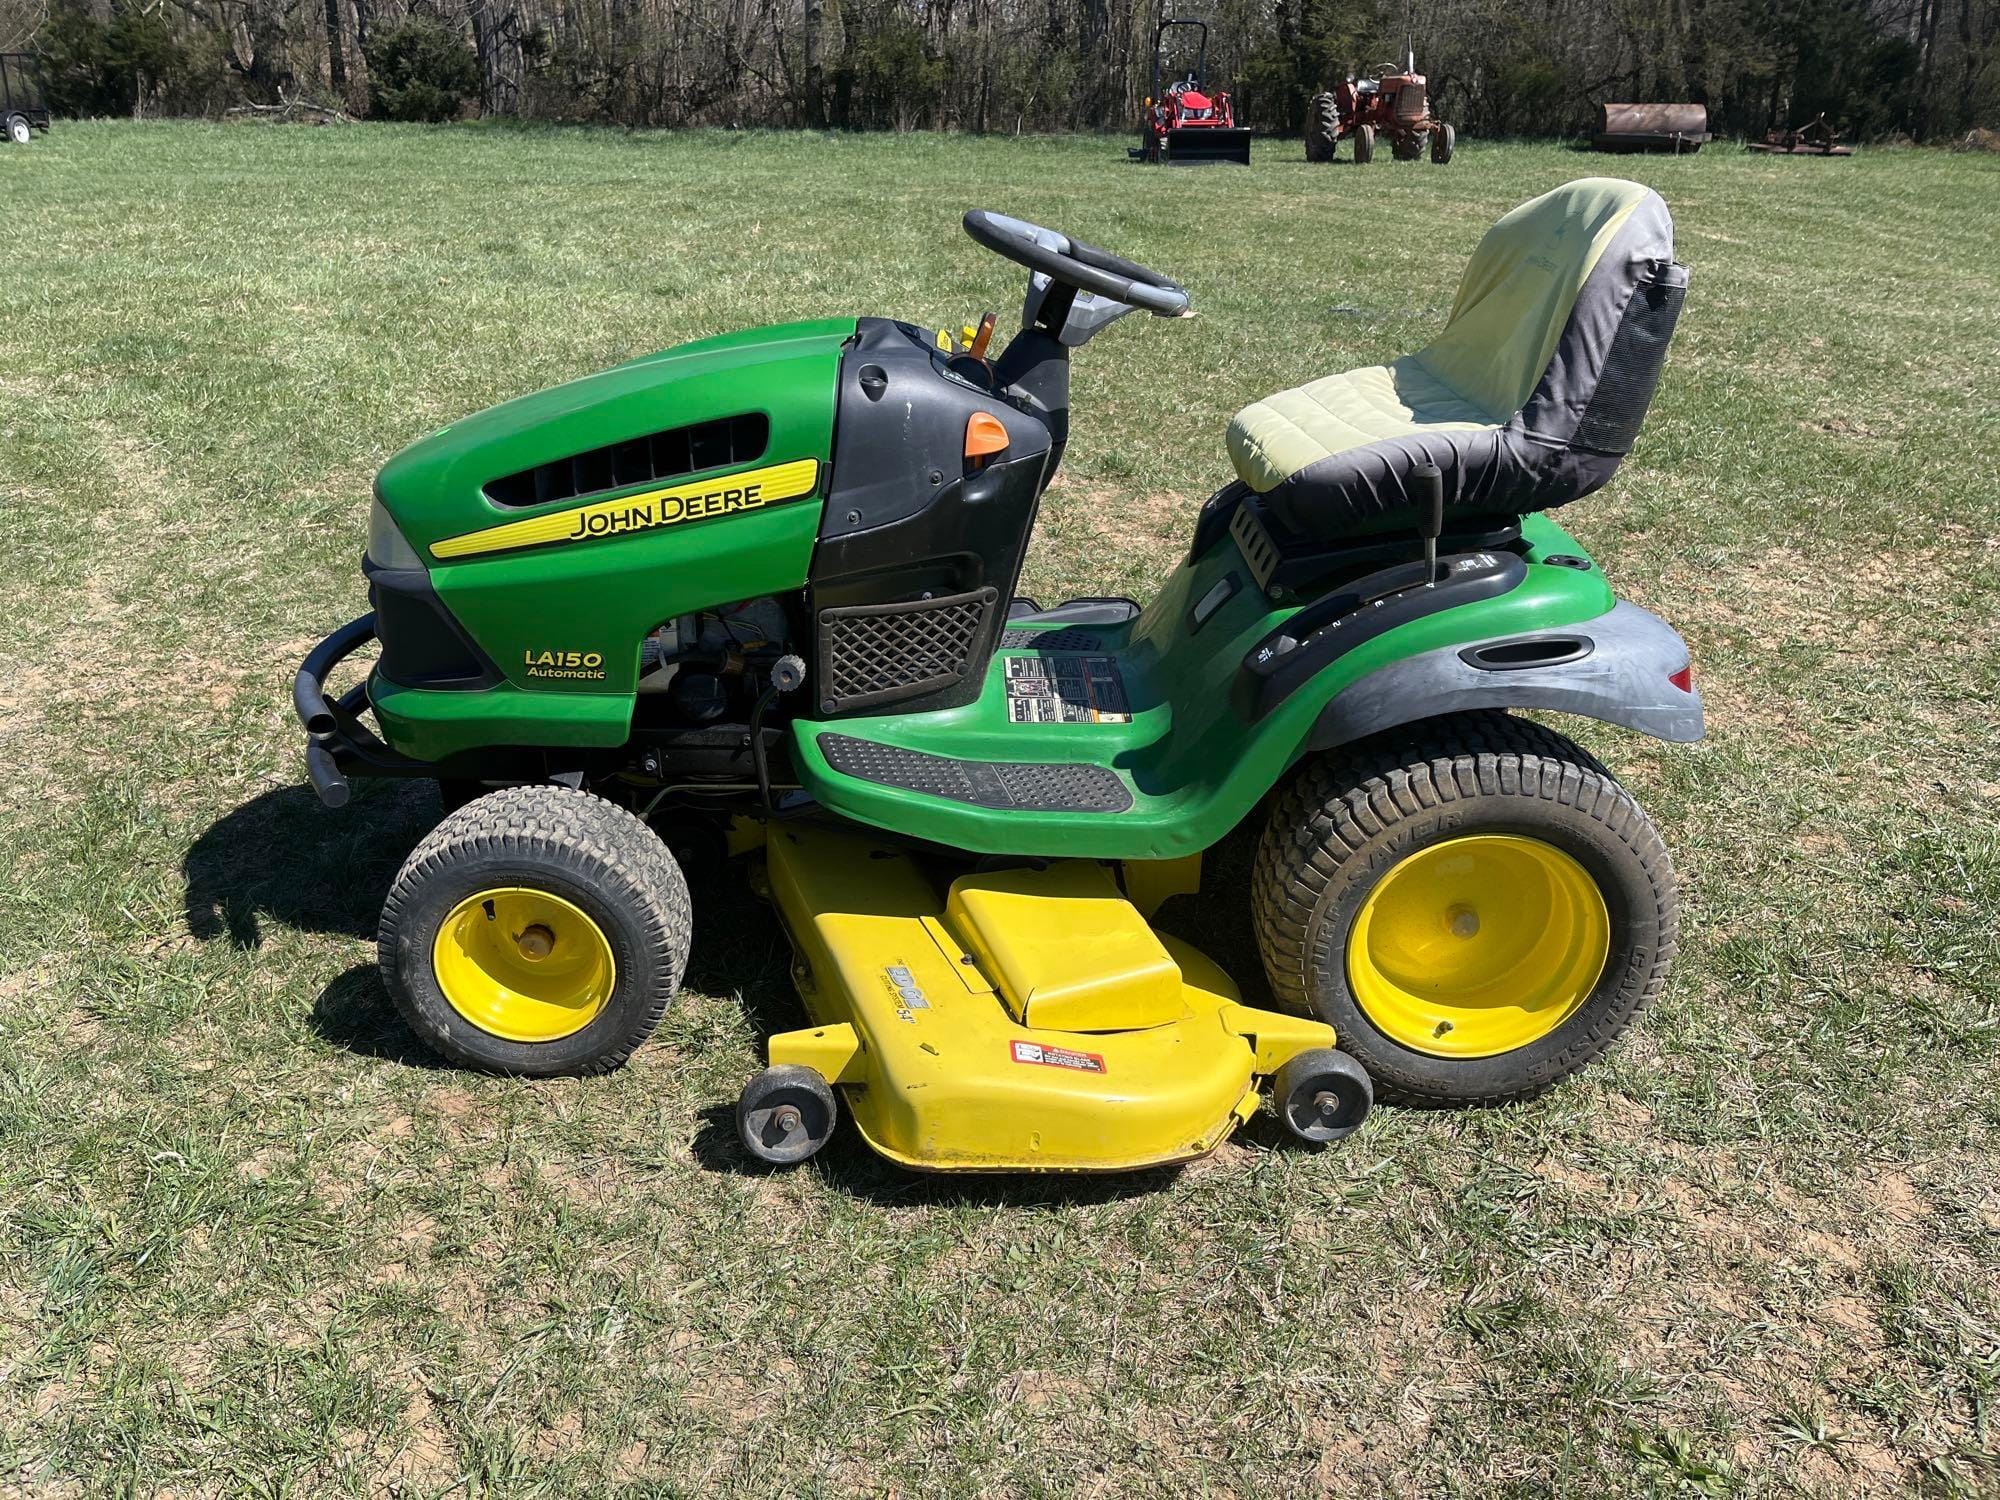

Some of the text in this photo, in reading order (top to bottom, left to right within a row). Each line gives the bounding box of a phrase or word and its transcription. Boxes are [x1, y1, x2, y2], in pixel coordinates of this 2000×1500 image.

[571, 484, 762, 537] JOHN DEERE
[1332, 619, 1342, 628] 2
[1374, 599, 1385, 608] 3
[525, 650, 602, 668] LA150
[527, 667, 605, 679] Automatic
[885, 966, 931, 1009] EDGE
[1526, 945, 1650, 1082] CARLISLE
